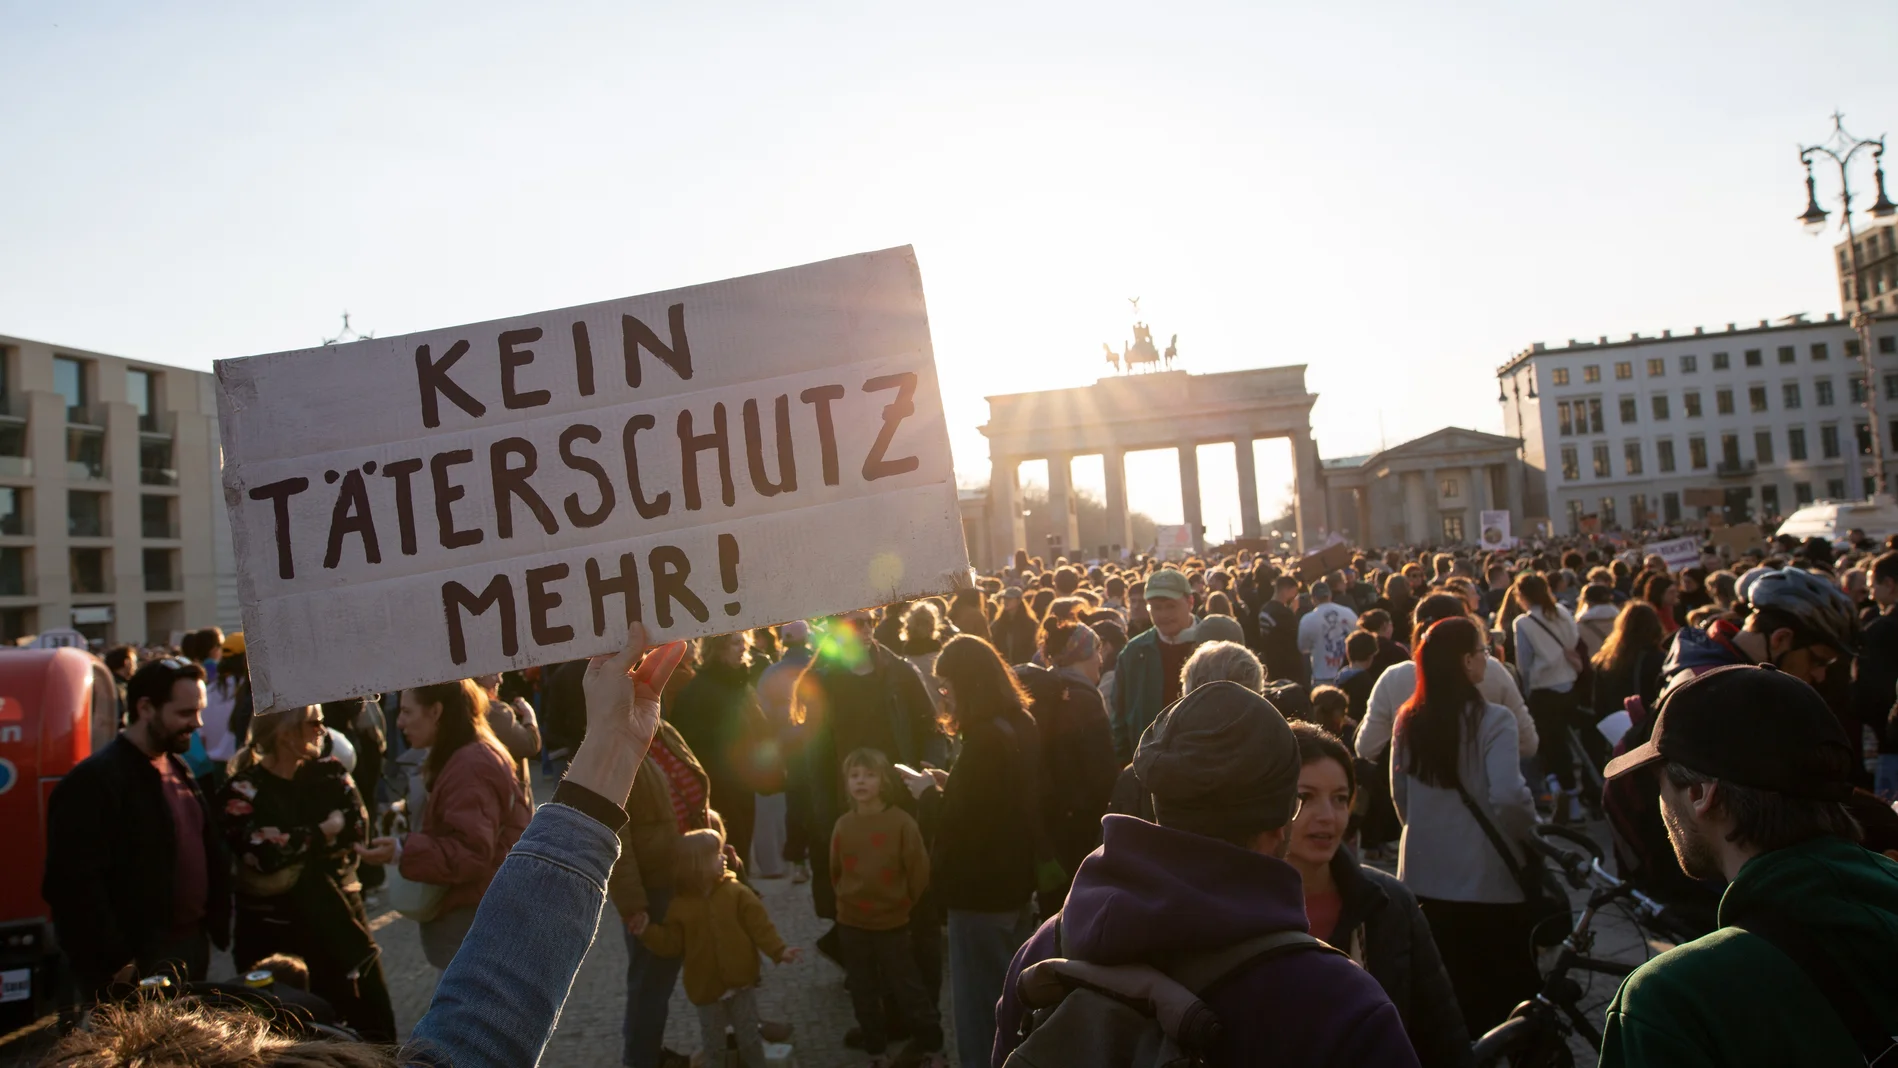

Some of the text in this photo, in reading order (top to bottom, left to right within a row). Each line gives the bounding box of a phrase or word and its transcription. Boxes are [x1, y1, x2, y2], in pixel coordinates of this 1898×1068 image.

[415, 303, 693, 429] KEIN
[249, 372, 920, 580] TÄTERSCHUTZ
[441, 533, 742, 664] MEHR!
